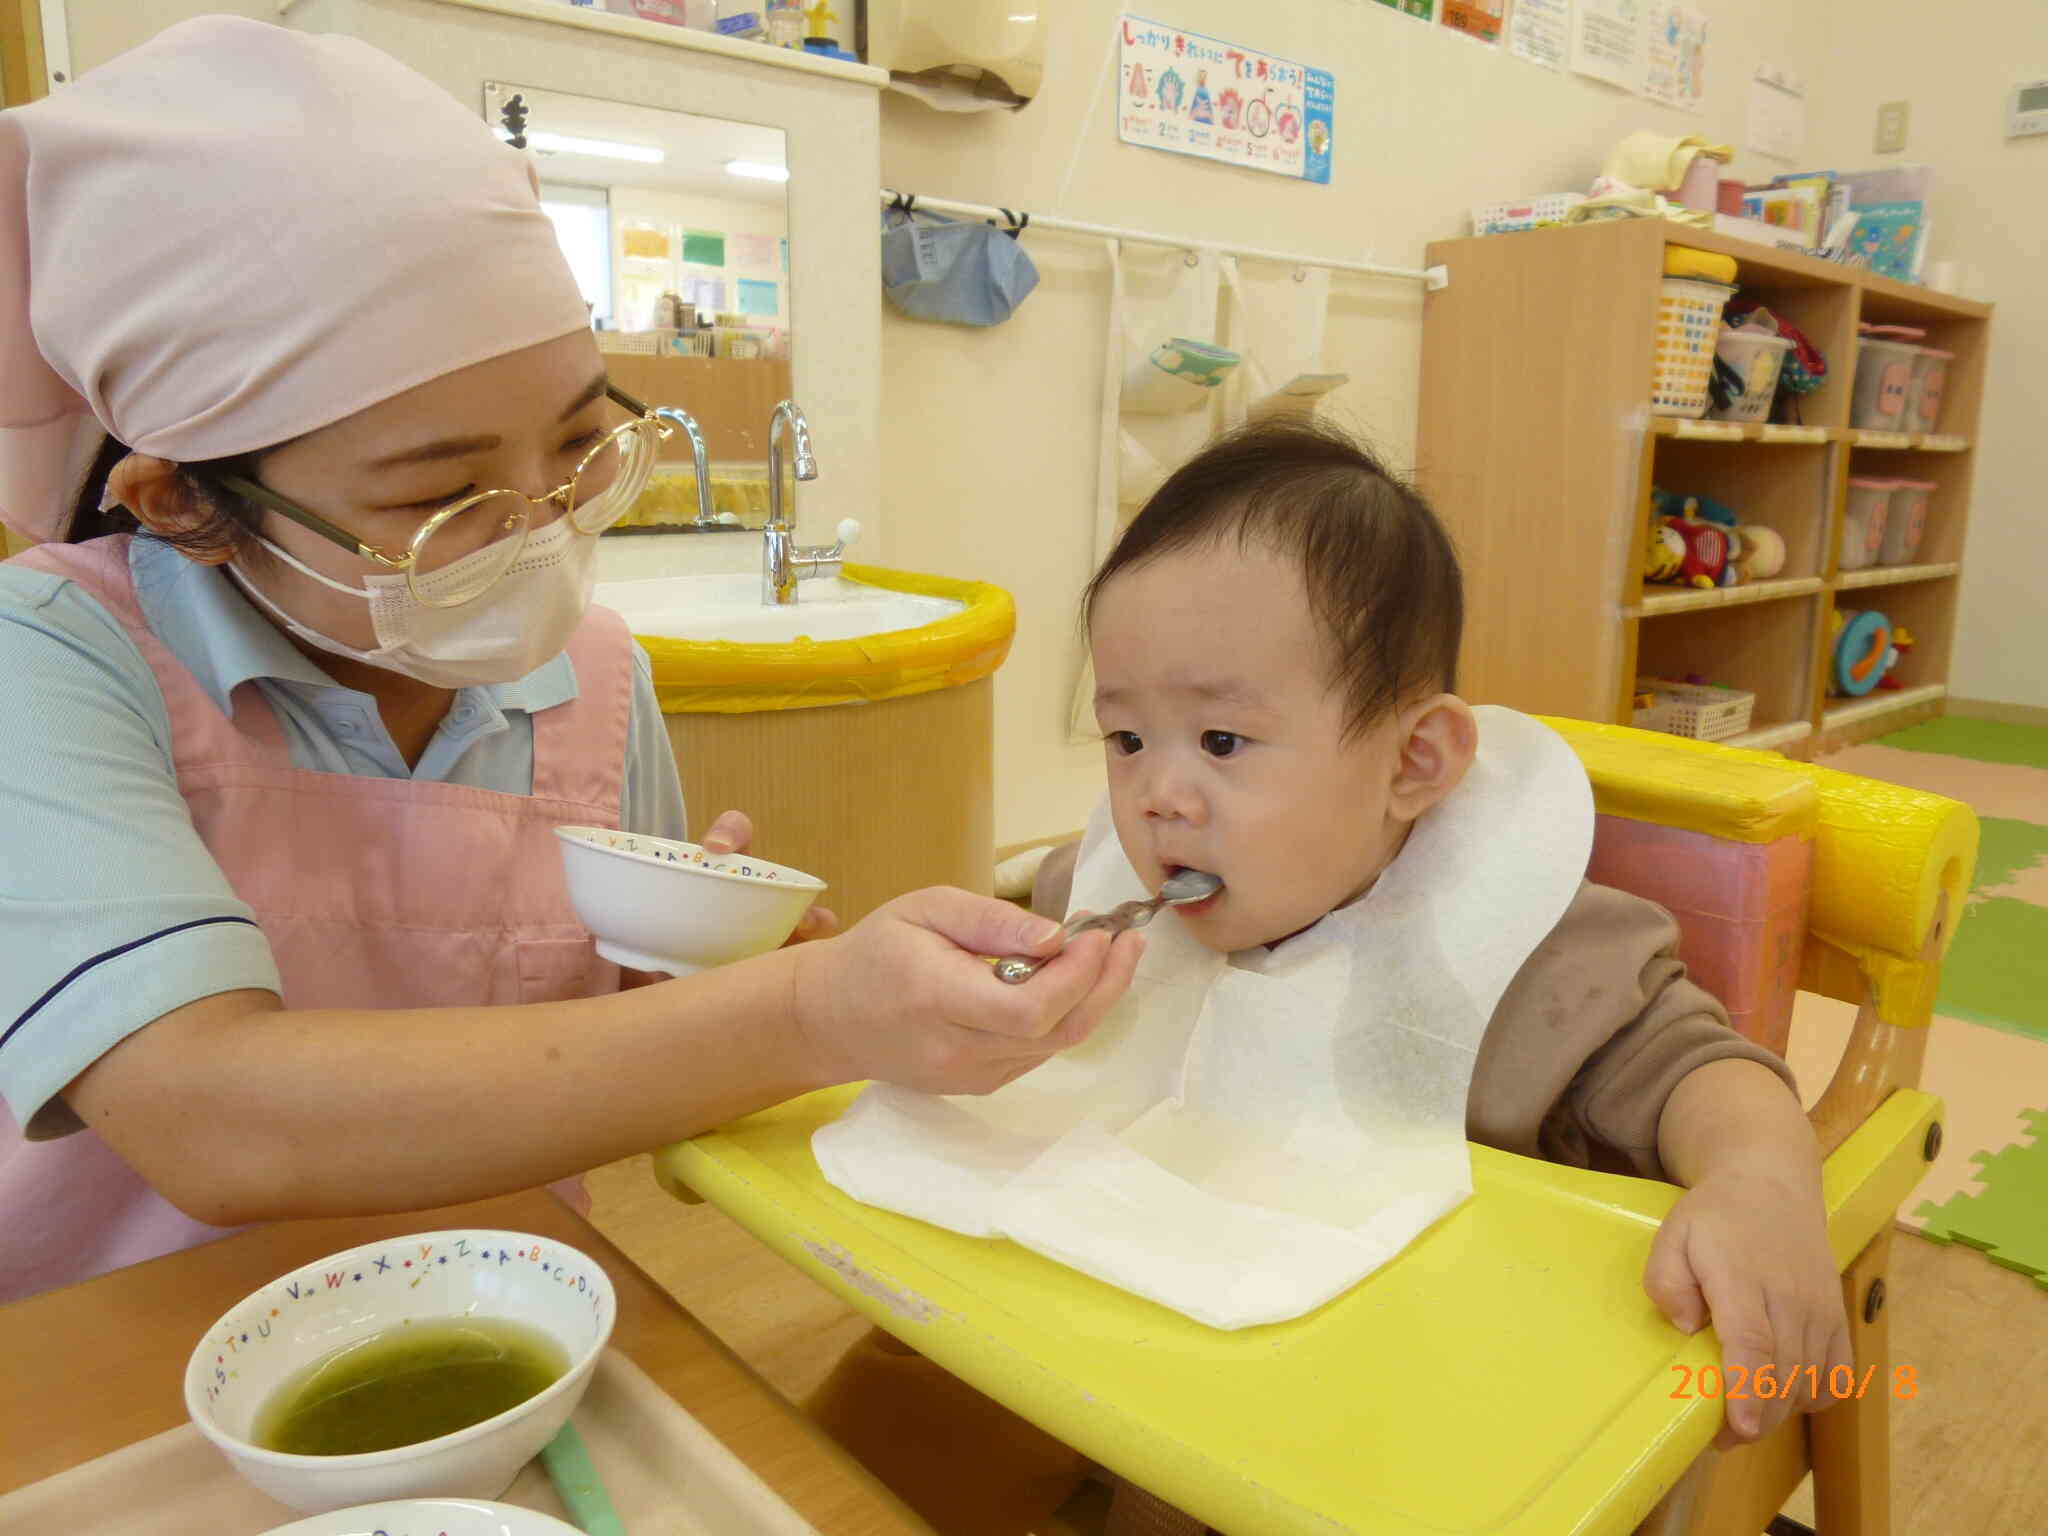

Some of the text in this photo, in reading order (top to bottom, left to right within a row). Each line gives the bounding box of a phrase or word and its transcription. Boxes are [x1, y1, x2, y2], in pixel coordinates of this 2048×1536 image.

[257, 1319, 271, 1338] U
[286, 1281, 299, 1300] V
[325, 1271, 346, 1289] W
[372, 1255, 392, 1276] X
[454, 1239, 472, 1257] Z
